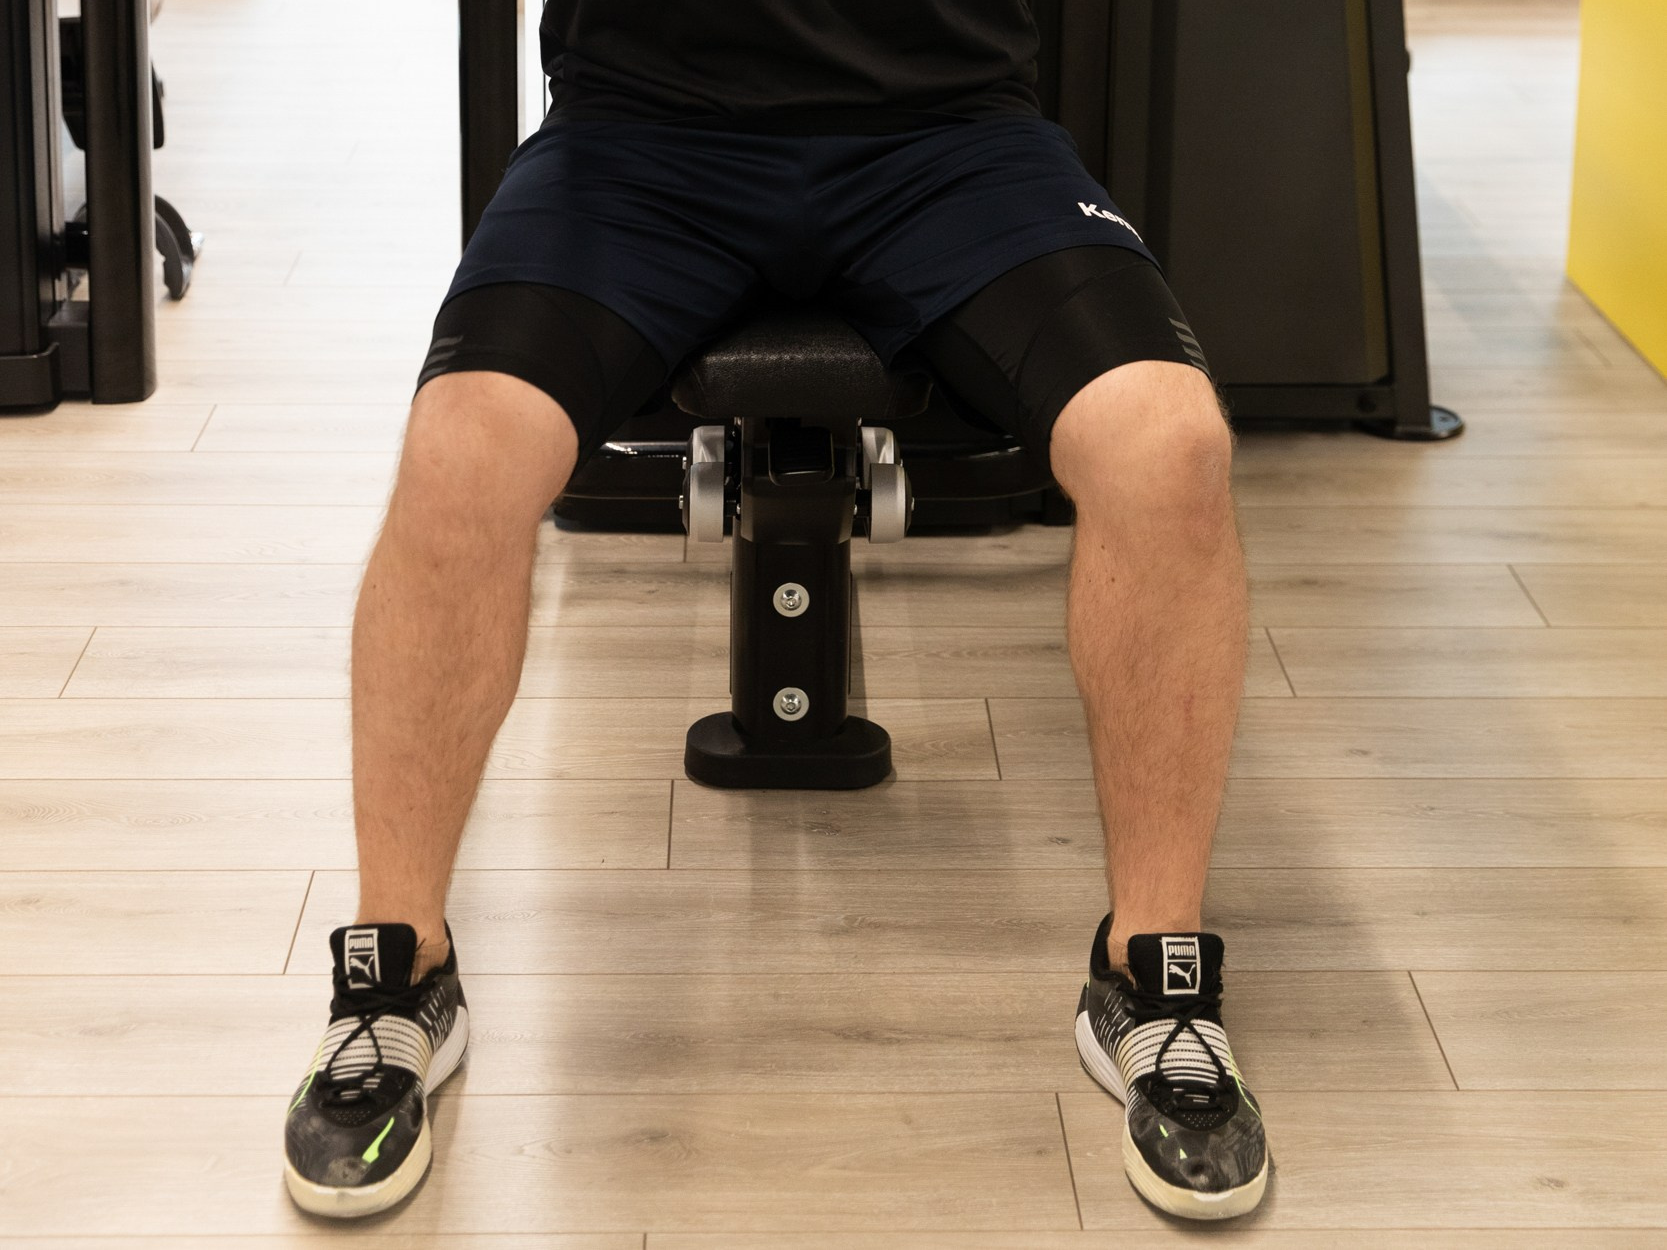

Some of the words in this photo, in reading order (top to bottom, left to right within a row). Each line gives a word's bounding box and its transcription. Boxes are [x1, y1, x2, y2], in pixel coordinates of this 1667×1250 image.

[1077, 202, 1143, 243] Kem
[349, 937, 374, 950] PUMA
[1167, 944, 1196, 957] PUMA
